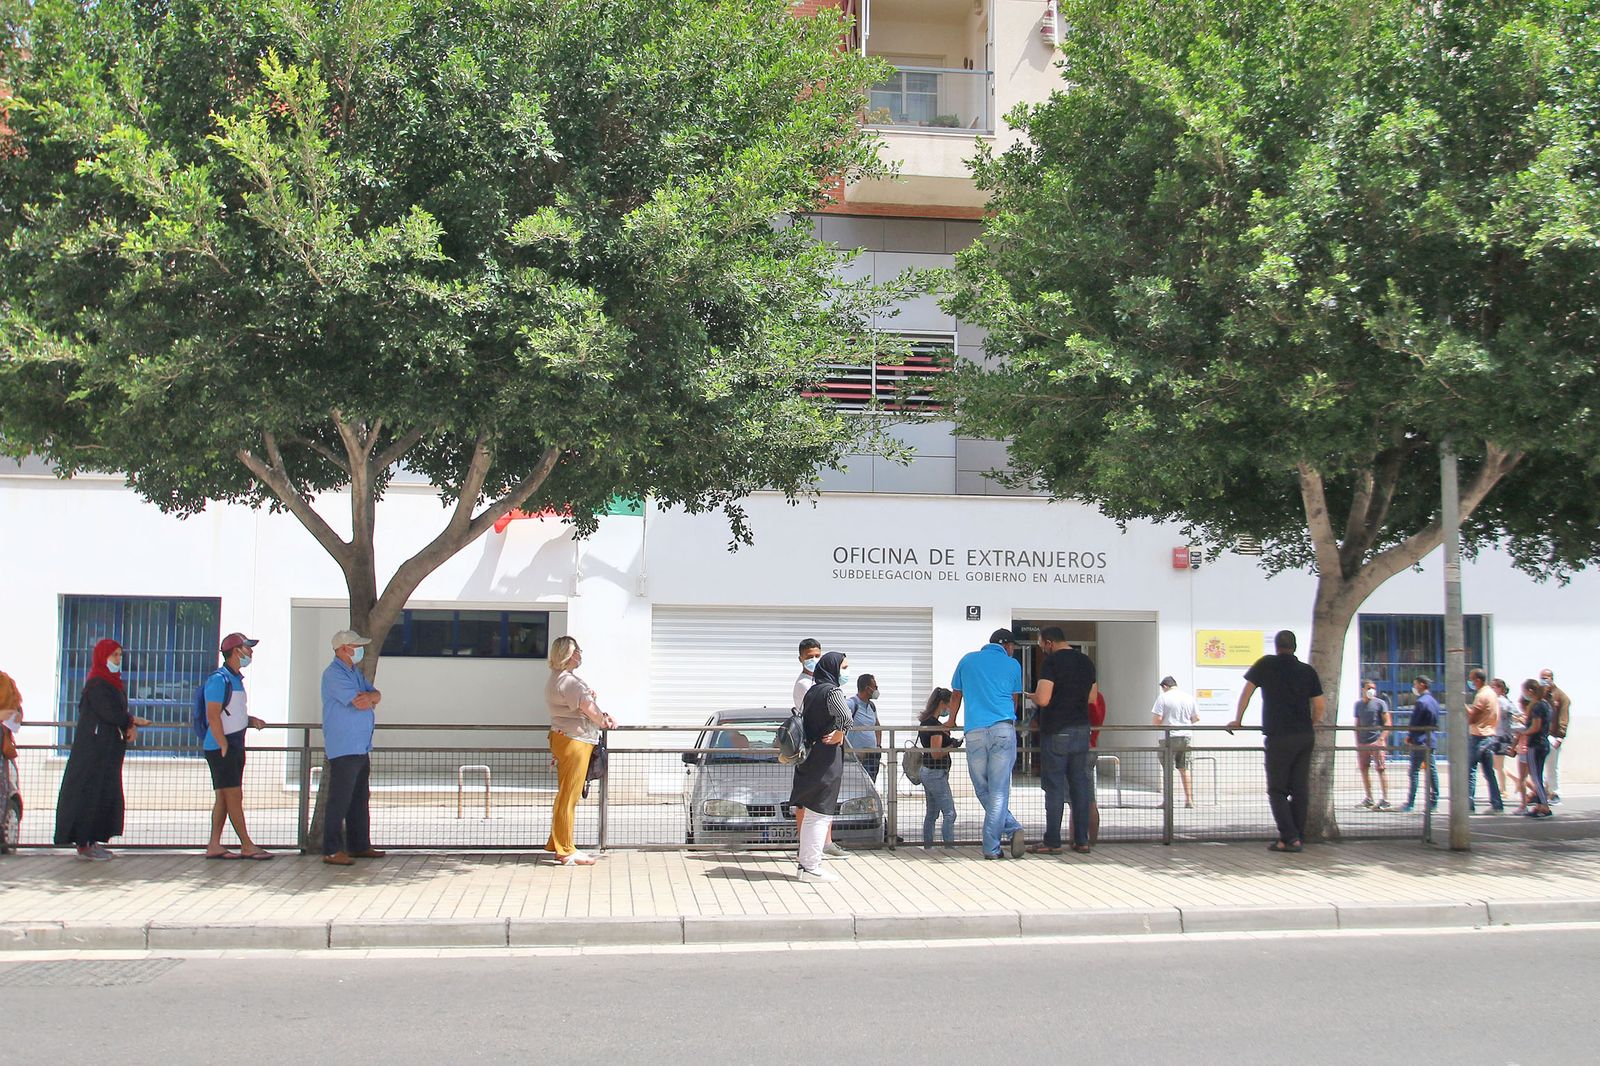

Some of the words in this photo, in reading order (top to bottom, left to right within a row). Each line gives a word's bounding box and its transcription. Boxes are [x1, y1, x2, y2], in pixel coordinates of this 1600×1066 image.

[832, 546, 919, 565] OFICINA
[929, 548, 955, 566] DE
[967, 549, 1107, 569] EXTRANJEROS
[832, 568, 932, 581] SUBDELEGACION
[938, 570, 961, 582] DEL
[965, 571, 1027, 583] GOBIERNO
[1032, 572, 1048, 583] EN
[1053, 573, 1106, 584] ALMERIA
